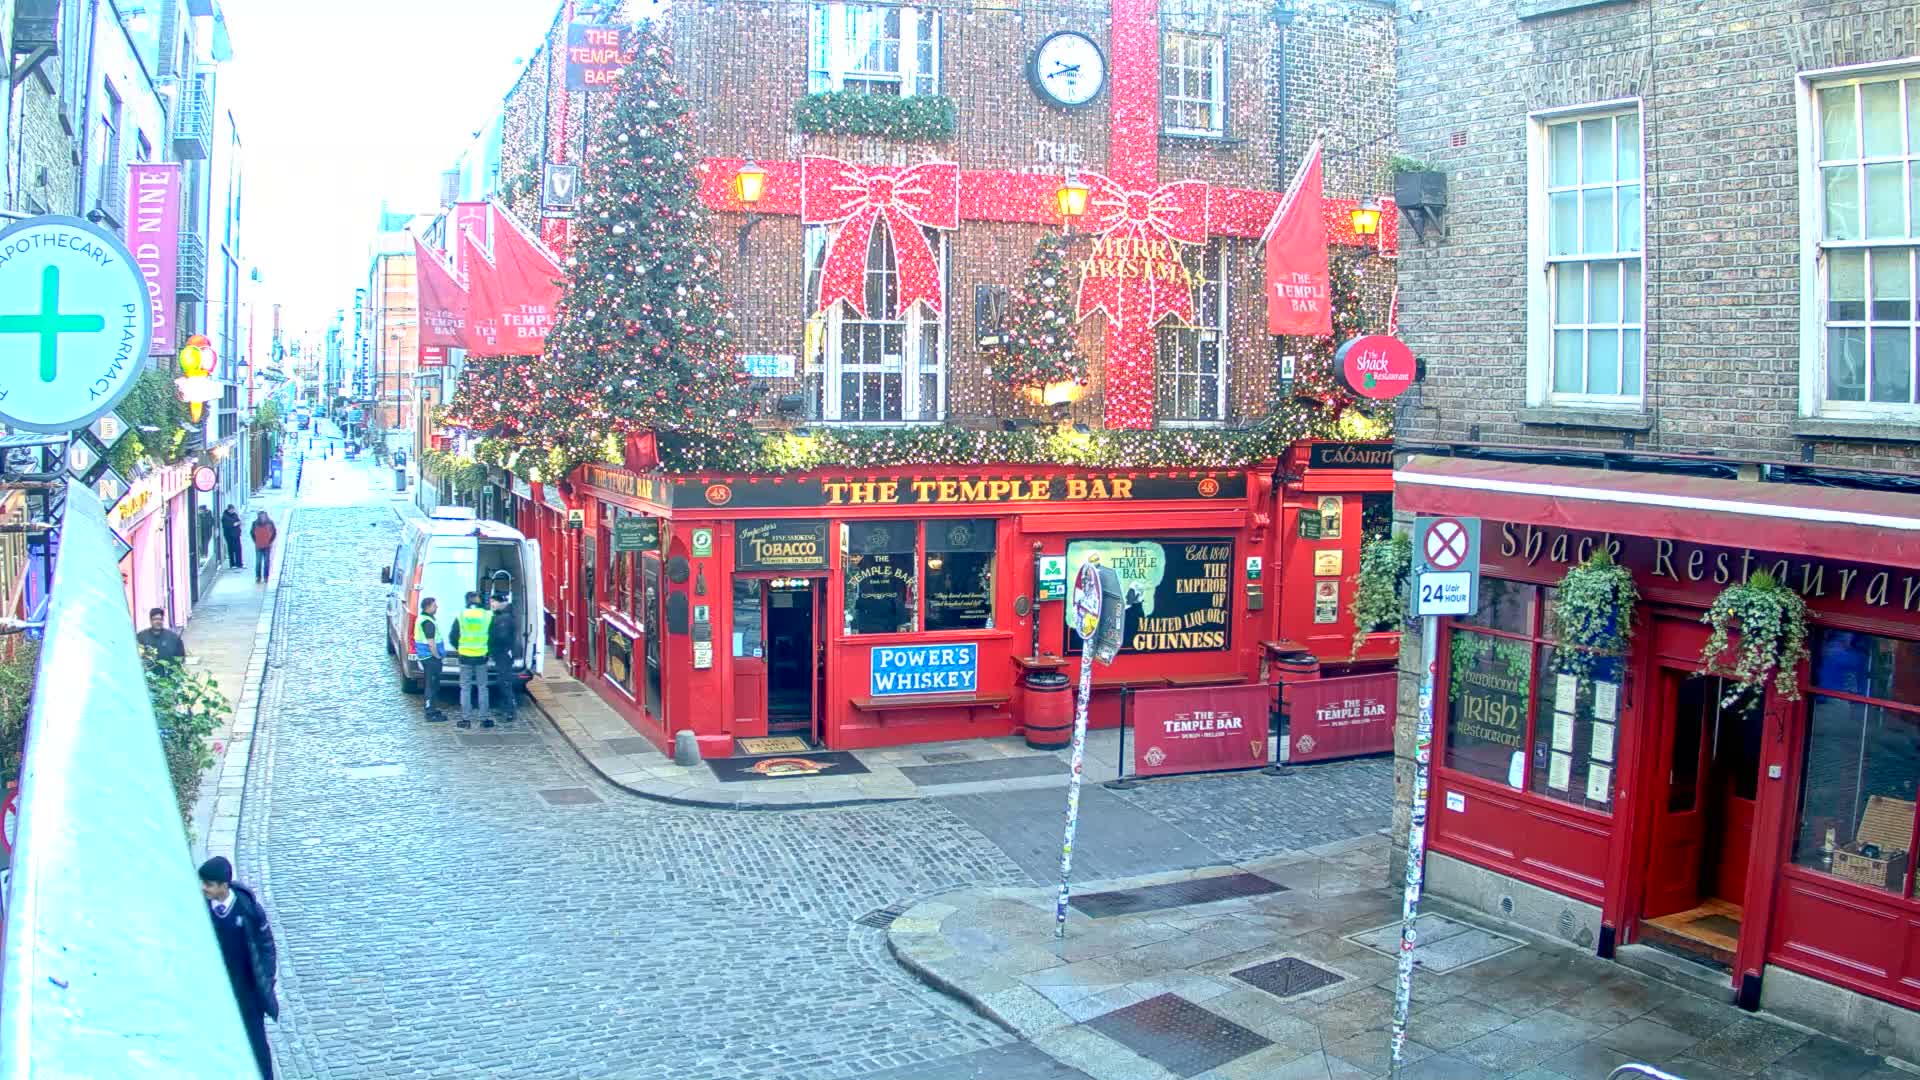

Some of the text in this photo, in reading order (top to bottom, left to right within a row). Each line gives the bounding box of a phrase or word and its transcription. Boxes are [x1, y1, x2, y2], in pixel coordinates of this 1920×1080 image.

[586, 30, 619, 45] THE
[137, 171, 170, 233] NINE
[1090, 236, 1184, 262] MERRY
[1292, 272, 1312, 285] THE
[519, 304, 545, 314] THE
[1291, 299, 1319, 312] BAR
[501, 313, 555, 327] TEMPL
[474, 326, 496, 336] TEM
[88, 302, 137, 401] PHARMACY
[637, 477, 653, 500] BAR
[710, 488, 727, 500] 48
[823, 477, 1133, 504] THE TEMPLE BAR
[1201, 482, 1216, 494] 48
[1501, 520, 1623, 567] Shack
[1122, 546, 1147, 557] THE
[1111, 557, 1157, 568] TEMPLE
[848, 565, 893, 587] TEMPLE
[1122, 568, 1146, 579] BAR
[1203, 563, 1227, 578] THE
[1176, 579, 1226, 593] EMPEROR
[1422, 584, 1443, 603] 24
[1212, 593, 1226, 607] OF
[1445, 594, 1466, 603] HOUR
[1138, 608, 1228, 632] MALTED LIQUORS
[1132, 631, 1225, 651] GUINNESS
[880, 648, 970, 668] POWER'S
[874, 670, 975, 691] WHISKEY
[1344, 699, 1361, 709] THE
[1194, 711, 1214, 720] THE
[1316, 704, 1386, 721] TEMPLE BAR
[1164, 717, 1243, 733] TEMPLE BAR
